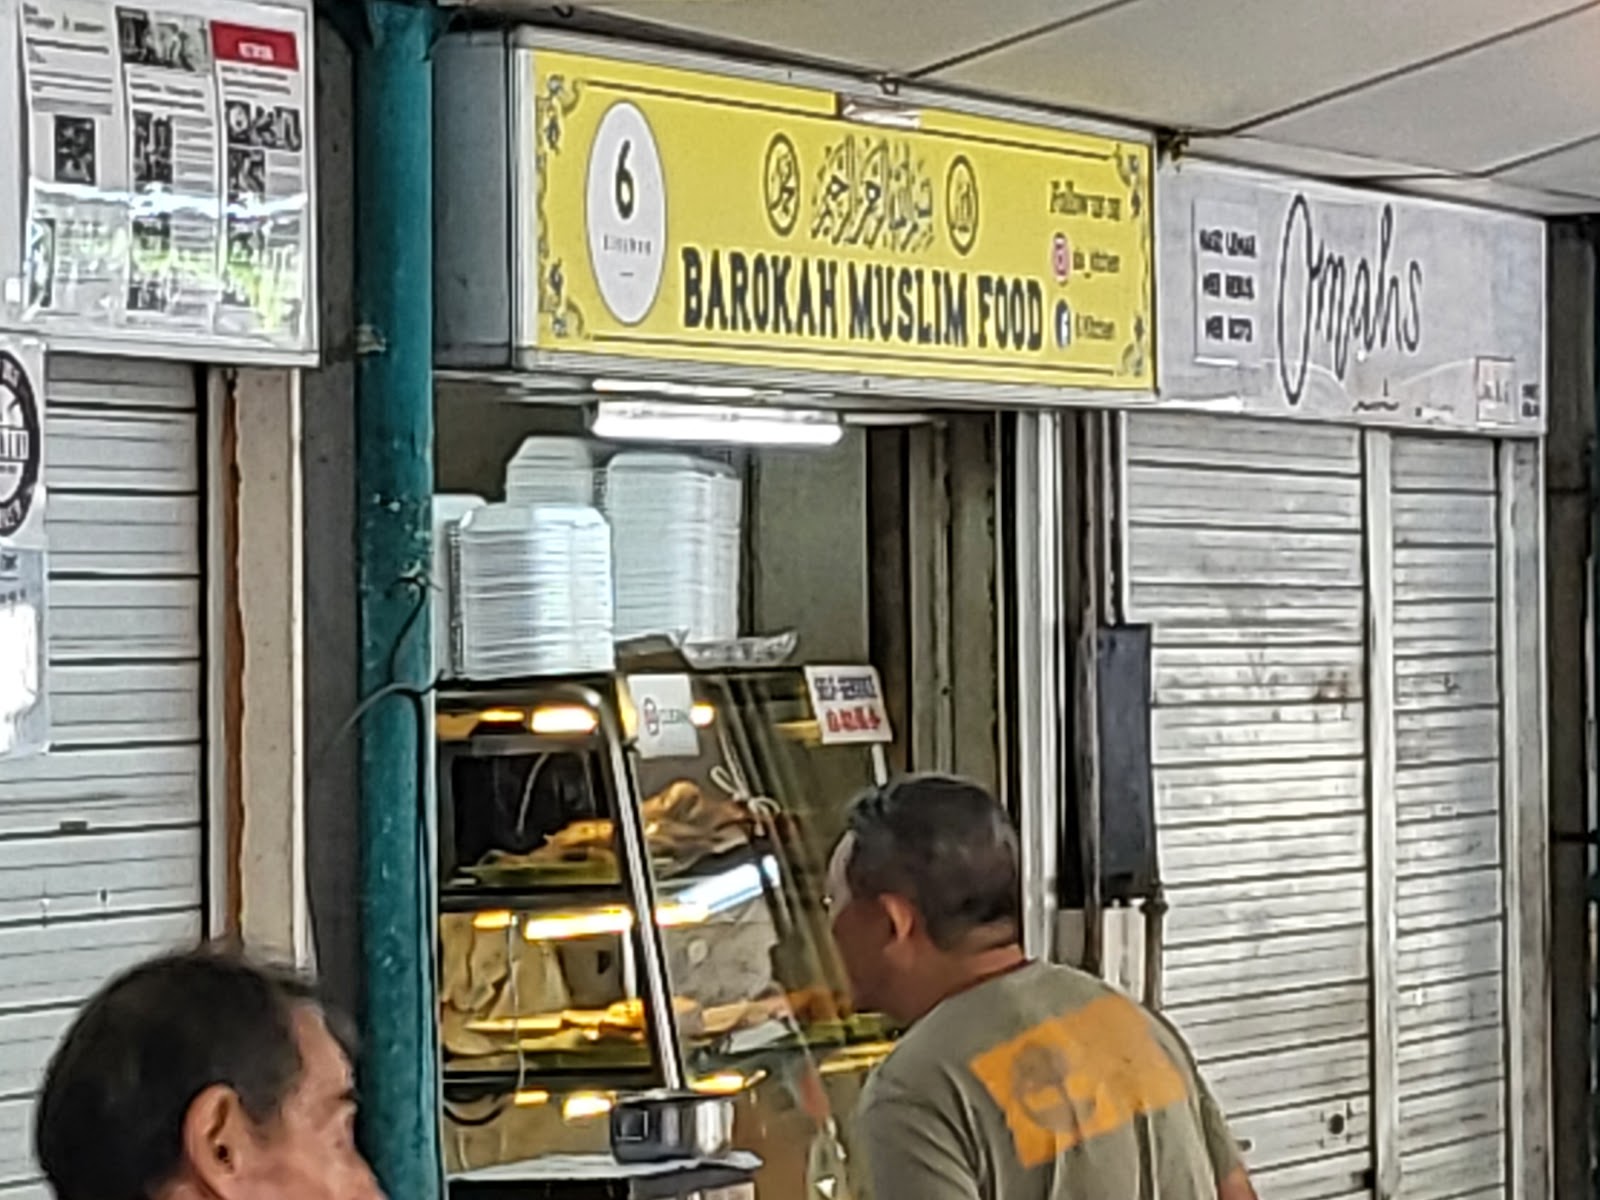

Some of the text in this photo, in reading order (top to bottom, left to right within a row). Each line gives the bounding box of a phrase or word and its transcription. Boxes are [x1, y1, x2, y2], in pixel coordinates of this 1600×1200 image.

[615, 138, 634, 220] 6
[682, 247, 1043, 351] BAROKAH MUSLIM FOOD
